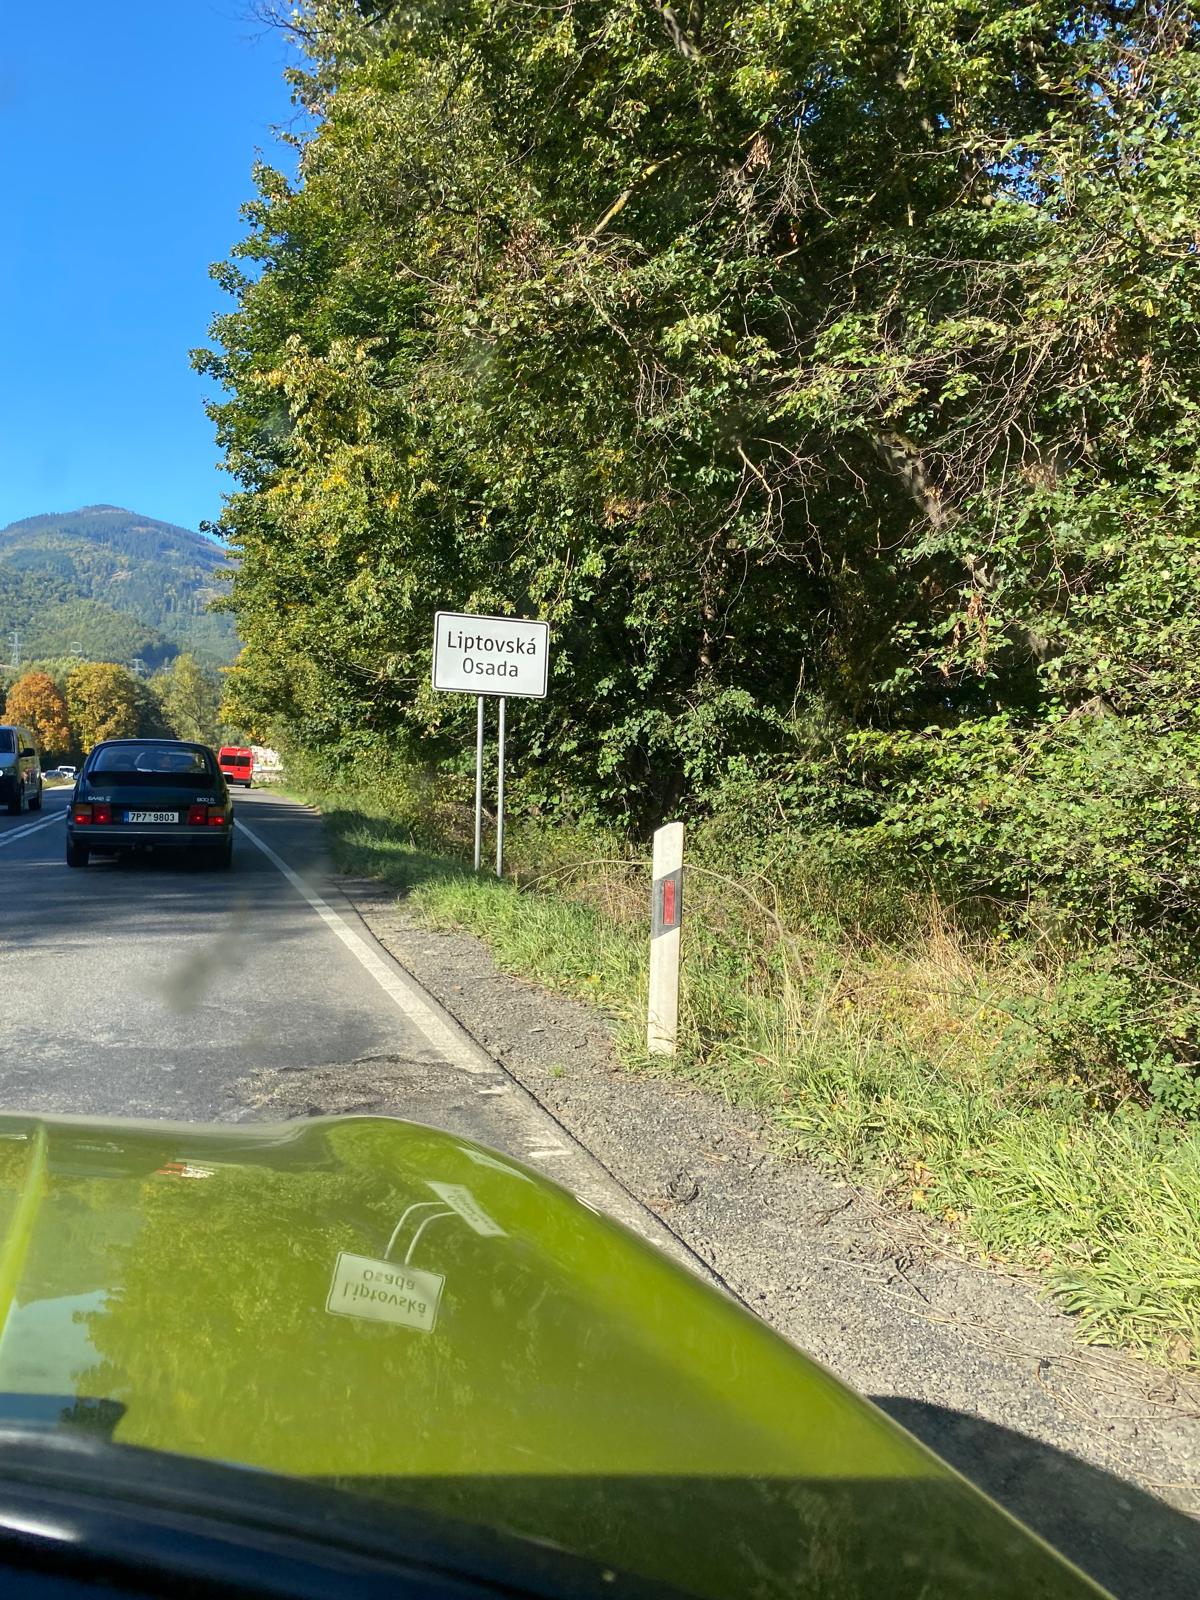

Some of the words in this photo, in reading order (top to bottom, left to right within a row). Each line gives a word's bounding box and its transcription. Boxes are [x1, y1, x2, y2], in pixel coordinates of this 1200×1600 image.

[447, 631, 536, 655] Liptovská
[462, 657, 518, 677] Osada
[131, 813, 146, 821] 7P7
[153, 813, 175, 821] 9803
